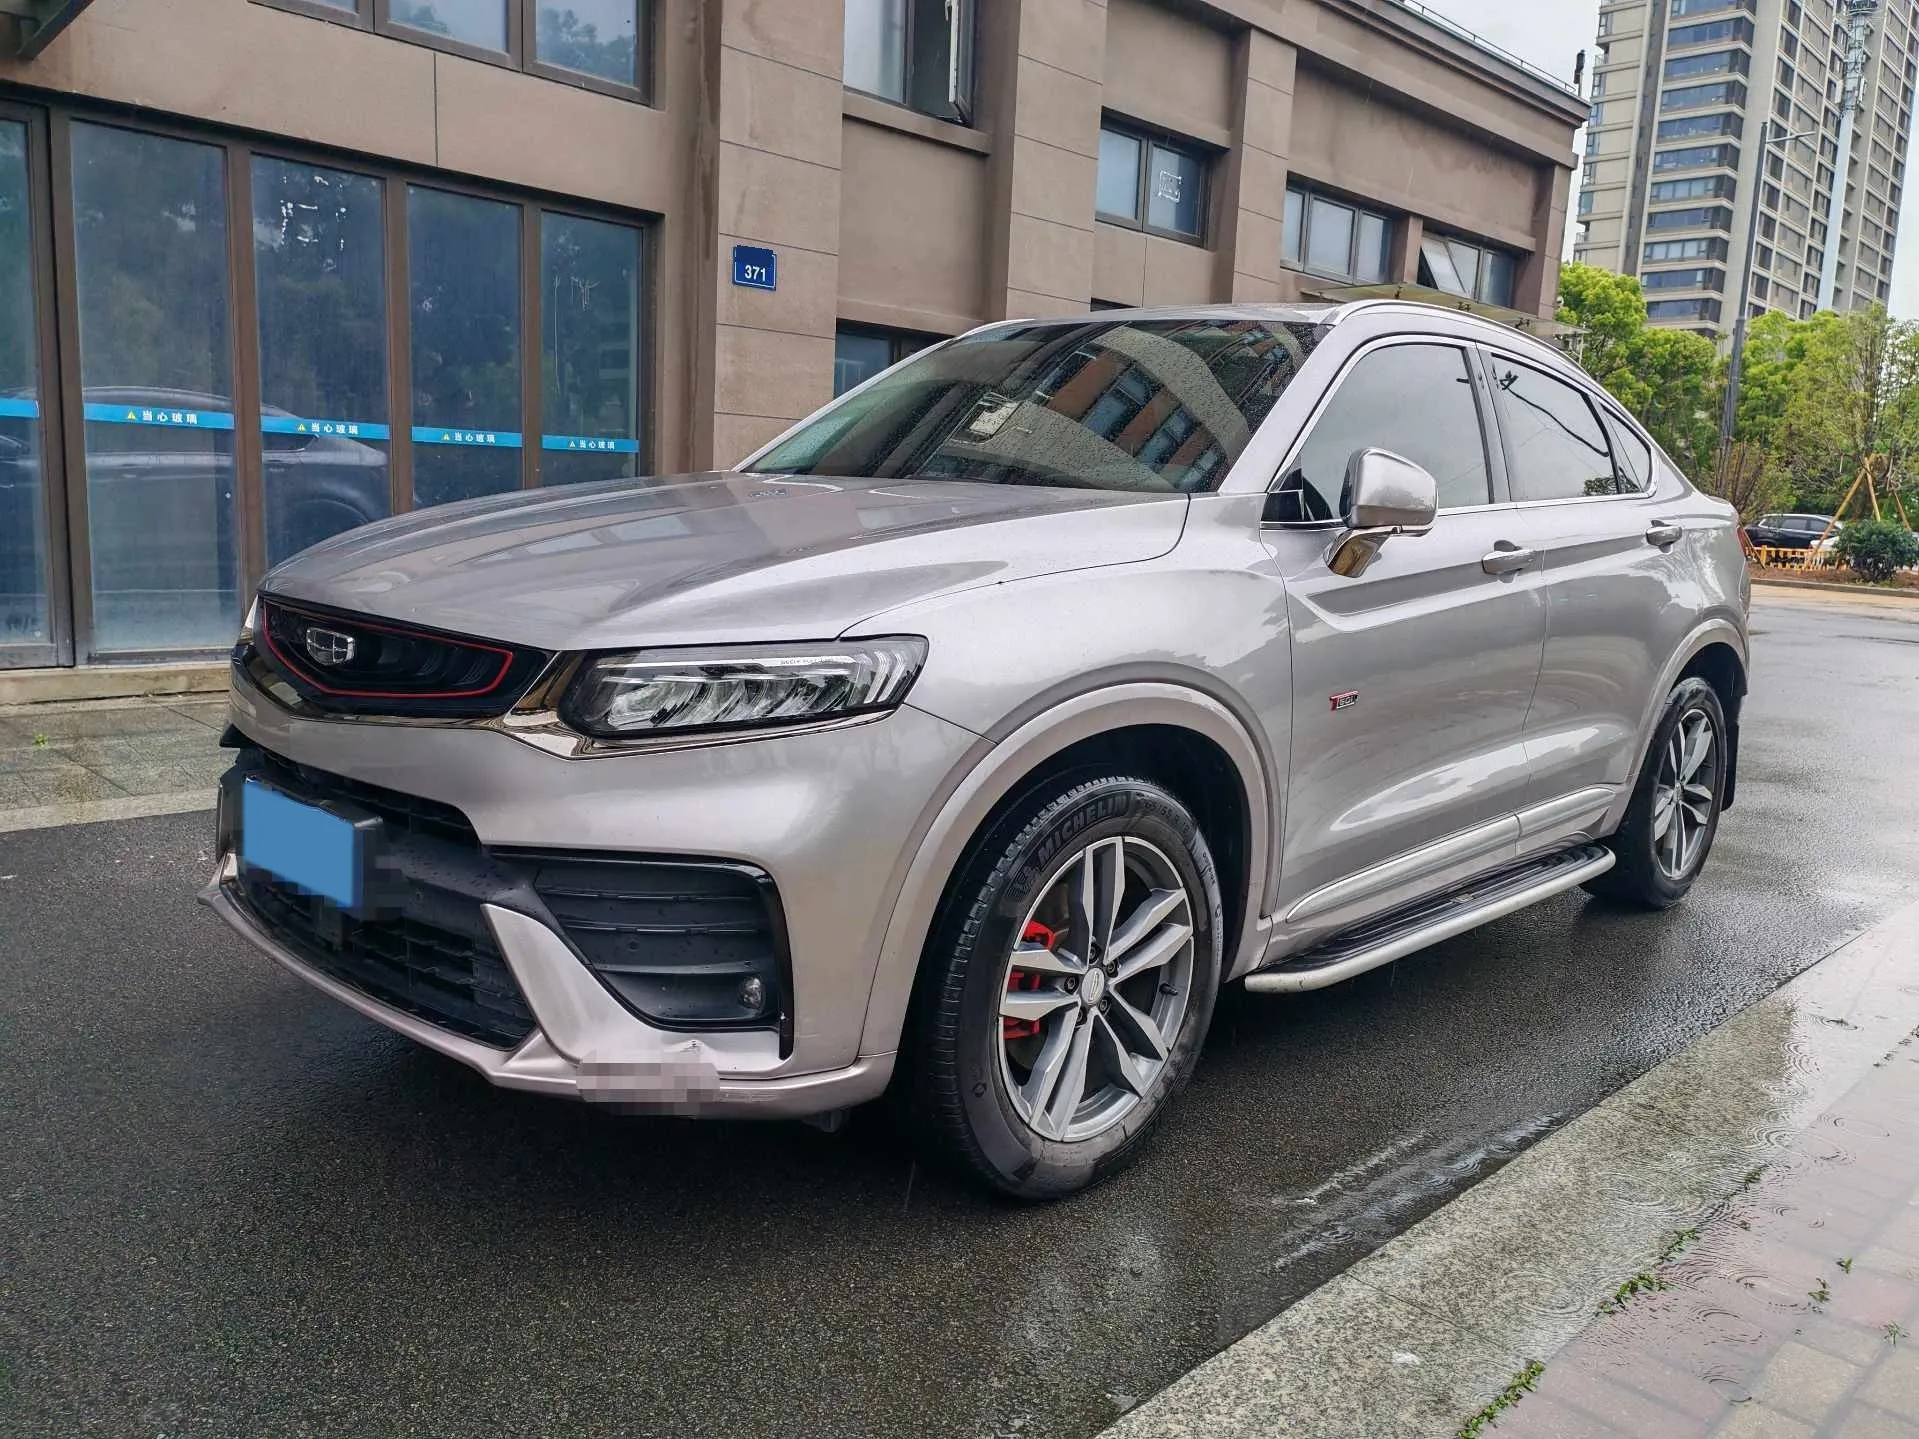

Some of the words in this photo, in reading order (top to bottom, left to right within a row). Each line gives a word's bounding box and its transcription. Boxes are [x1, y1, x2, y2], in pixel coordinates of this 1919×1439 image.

[744, 264, 766, 282] 371
[142, 410, 198, 425] 当心玻璃
[311, 422, 359, 435] 当心玻璃
[454, 432, 496, 444] 当心玻璃
[1037, 794, 1130, 866] MICHELIN
